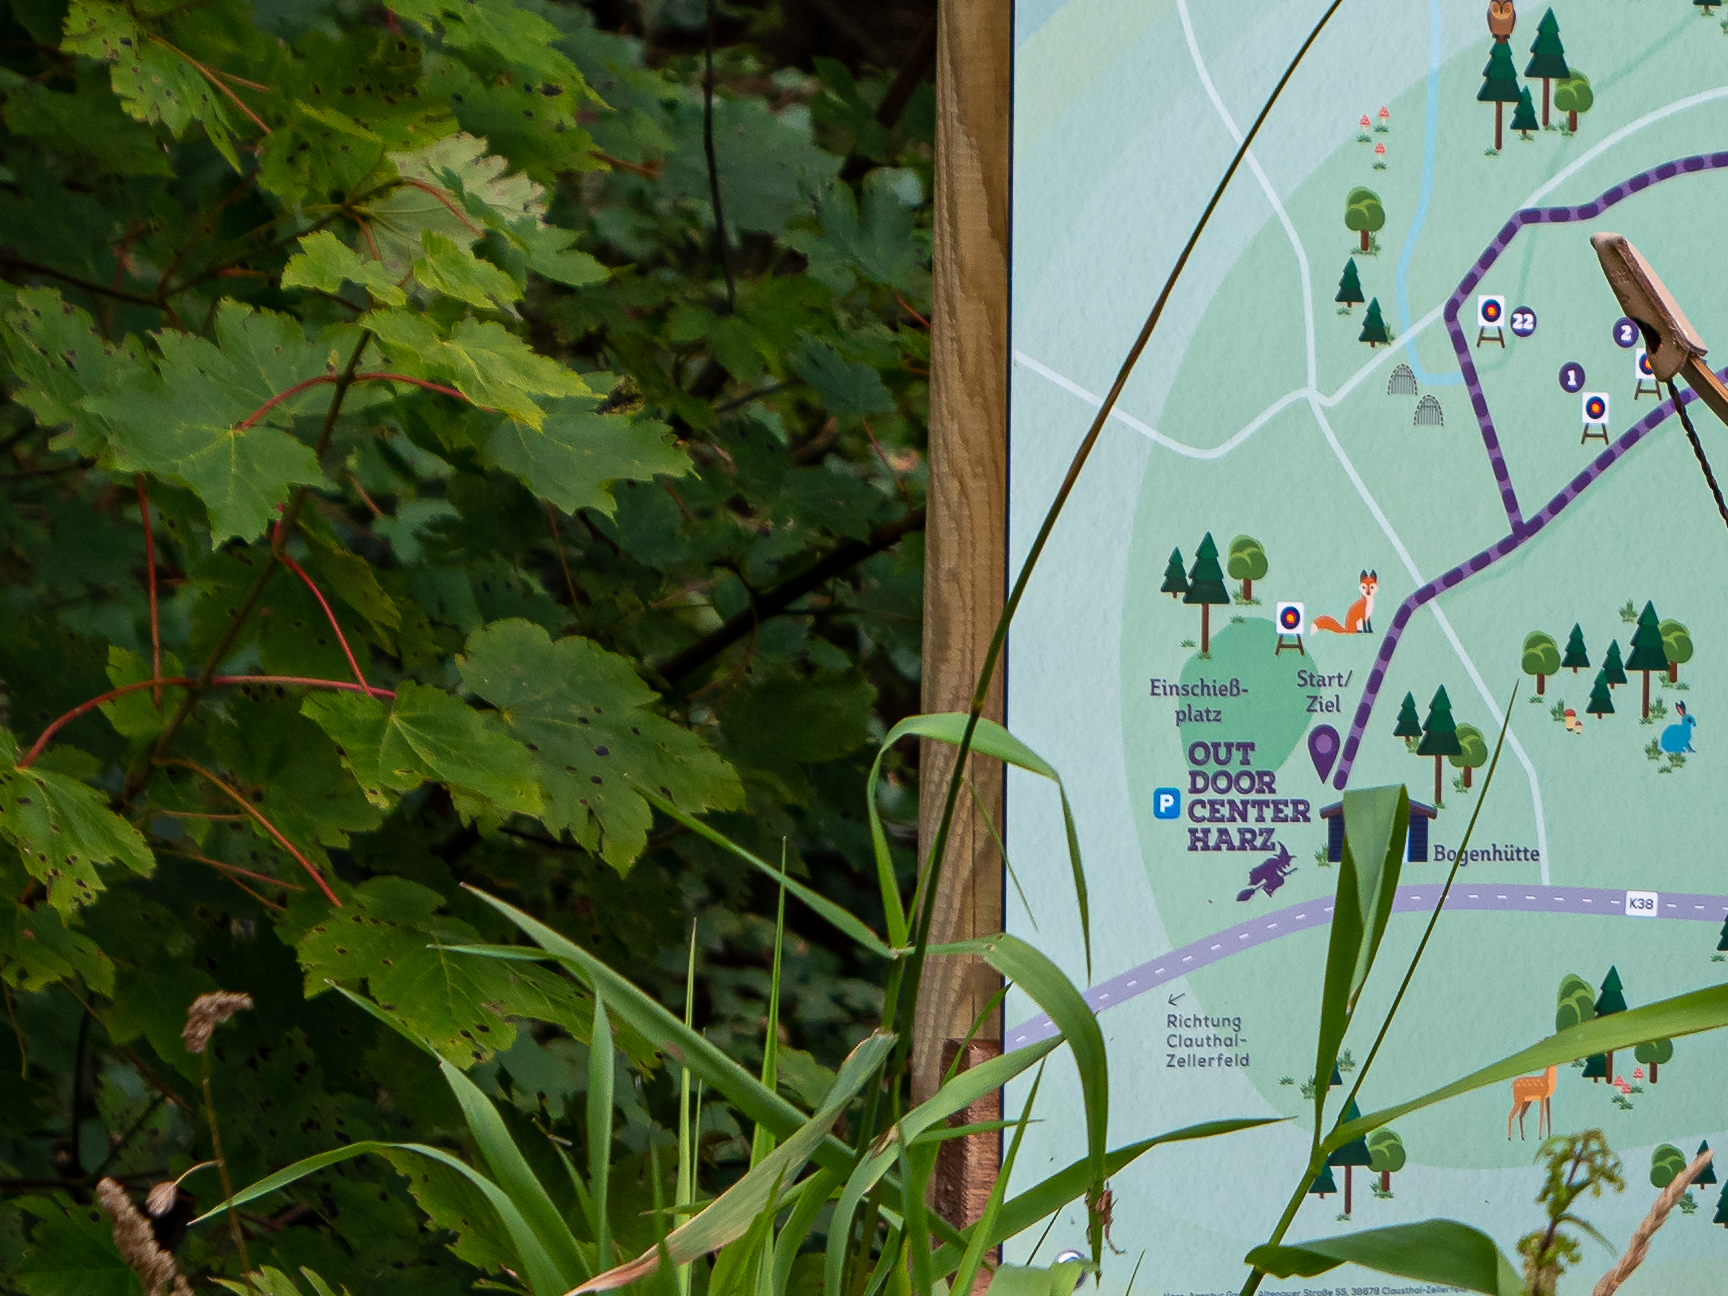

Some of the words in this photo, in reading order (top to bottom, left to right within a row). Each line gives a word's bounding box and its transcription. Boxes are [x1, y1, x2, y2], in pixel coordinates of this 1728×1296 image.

[1511, 314, 1535, 330] 22
[1619, 325, 1632, 341] 2
[1567, 369, 1577, 386] 1
[1150, 678, 1249, 698] Einschieß-
[1297, 669, 1353, 688] Start/
[1306, 694, 1341, 713] Ziel
[1175, 704, 1222, 727] platz
[1188, 740, 1256, 766] OUT
[1188, 769, 1277, 795] DOOR
[1160, 794, 1174, 813] P
[1187, 798, 1311, 823] CENTER
[1187, 827, 1276, 852] HARZ
[1433, 843, 1540, 867] Bogenhütte
[1629, 897, 1654, 910] K38
[1167, 1013, 1242, 1033] Richtung
[1167, 1033, 1248, 1049] Clauthal-
[1166, 1052, 1250, 1068] Zellerfeld
